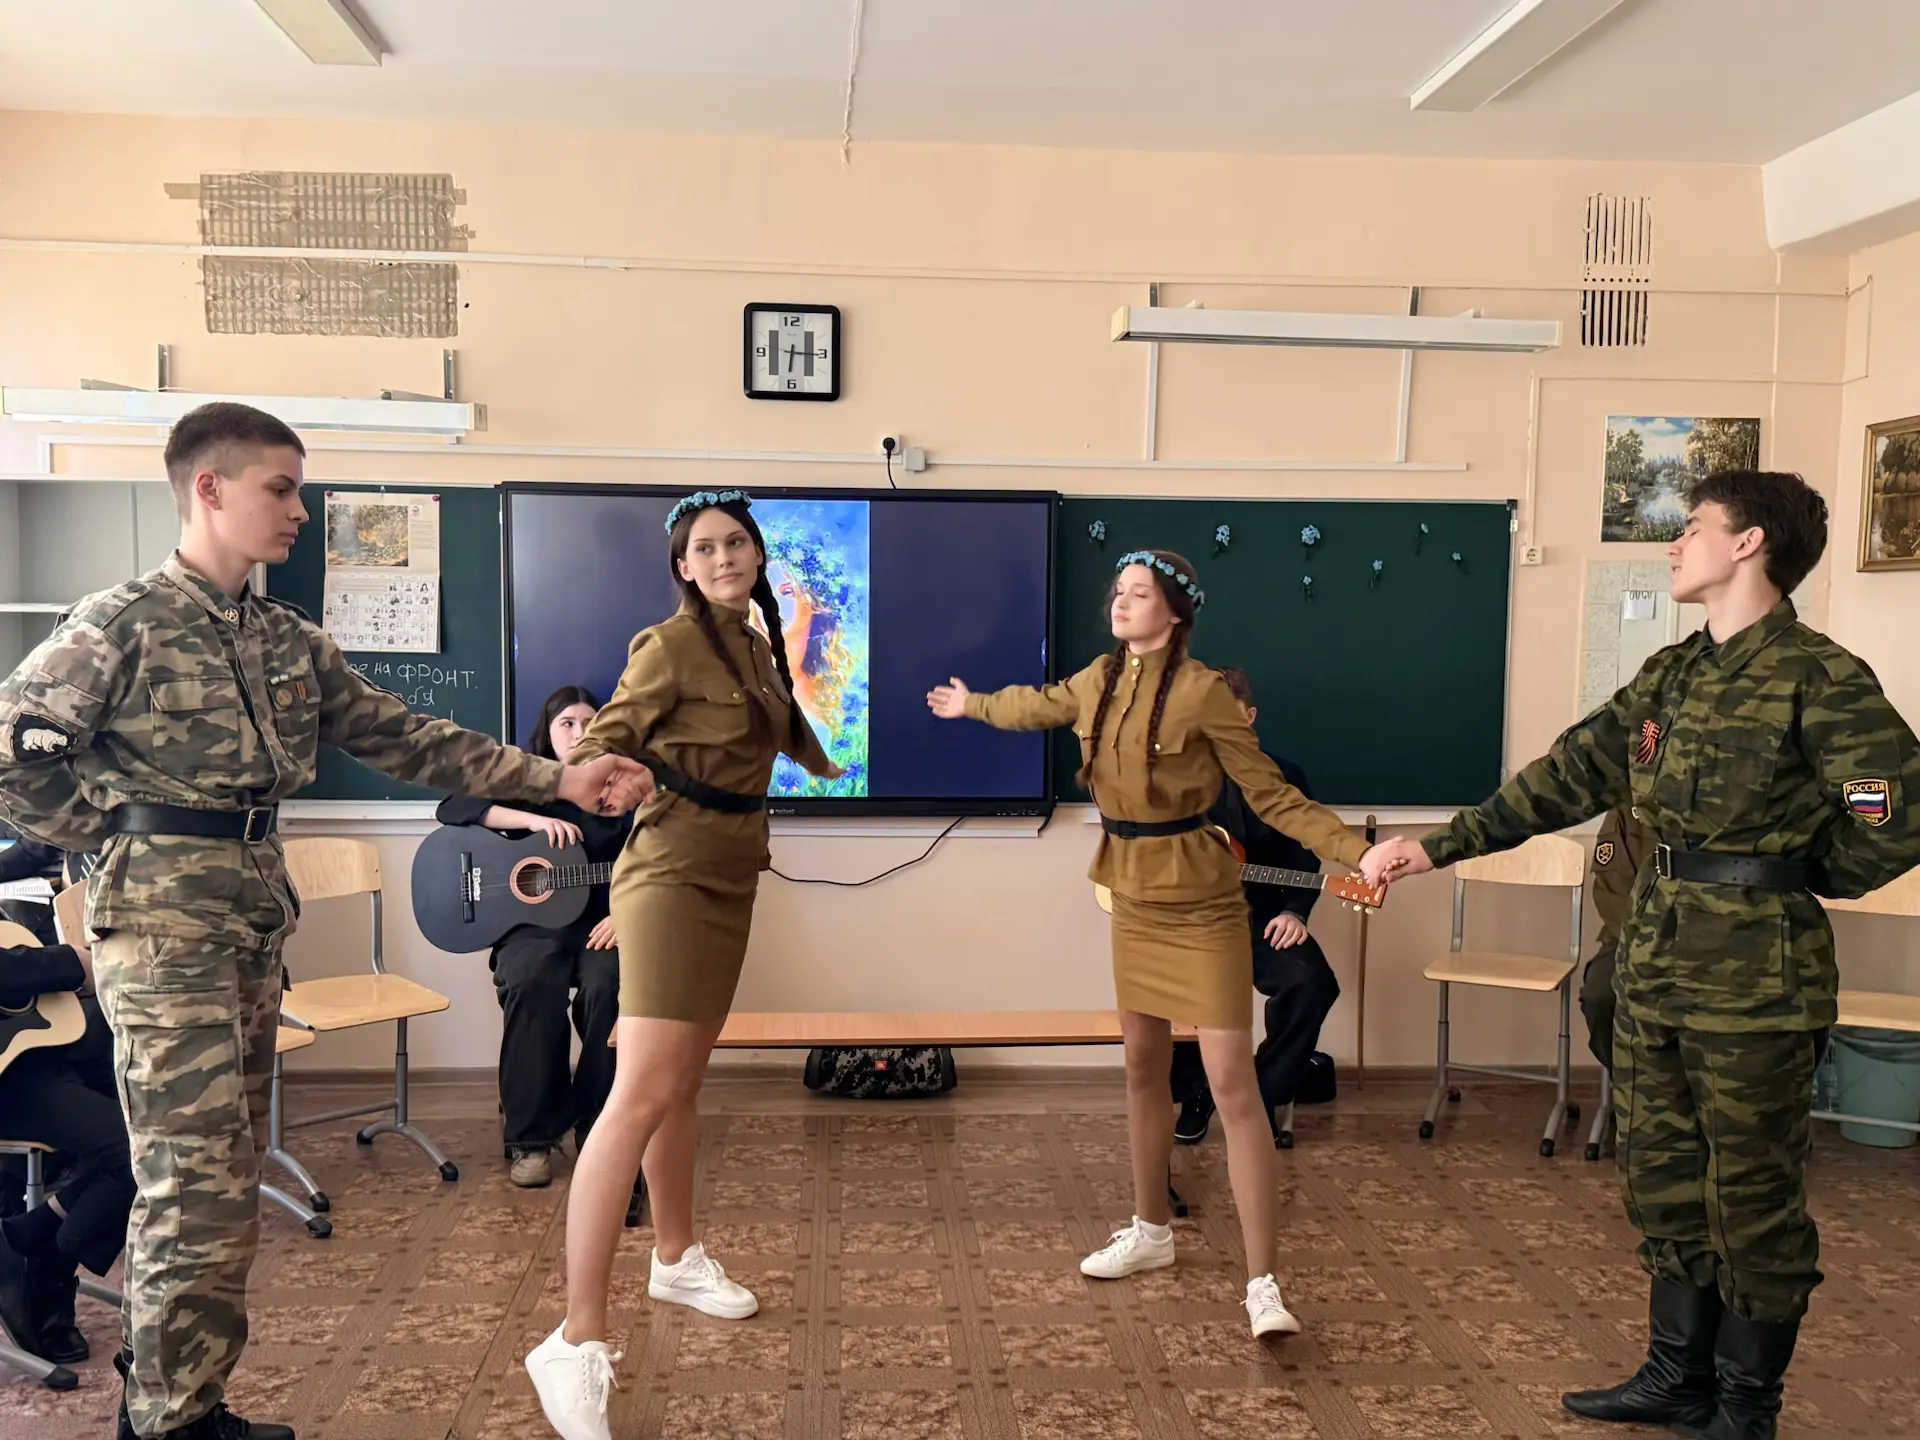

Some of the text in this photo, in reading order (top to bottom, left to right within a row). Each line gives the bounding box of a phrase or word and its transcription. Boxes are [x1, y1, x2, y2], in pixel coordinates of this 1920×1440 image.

[783, 316, 800, 327] 12
[756, 347, 828, 359] 9 3
[787, 379, 797, 389] 6
[1846, 783, 1885, 793] РОССИЯ
